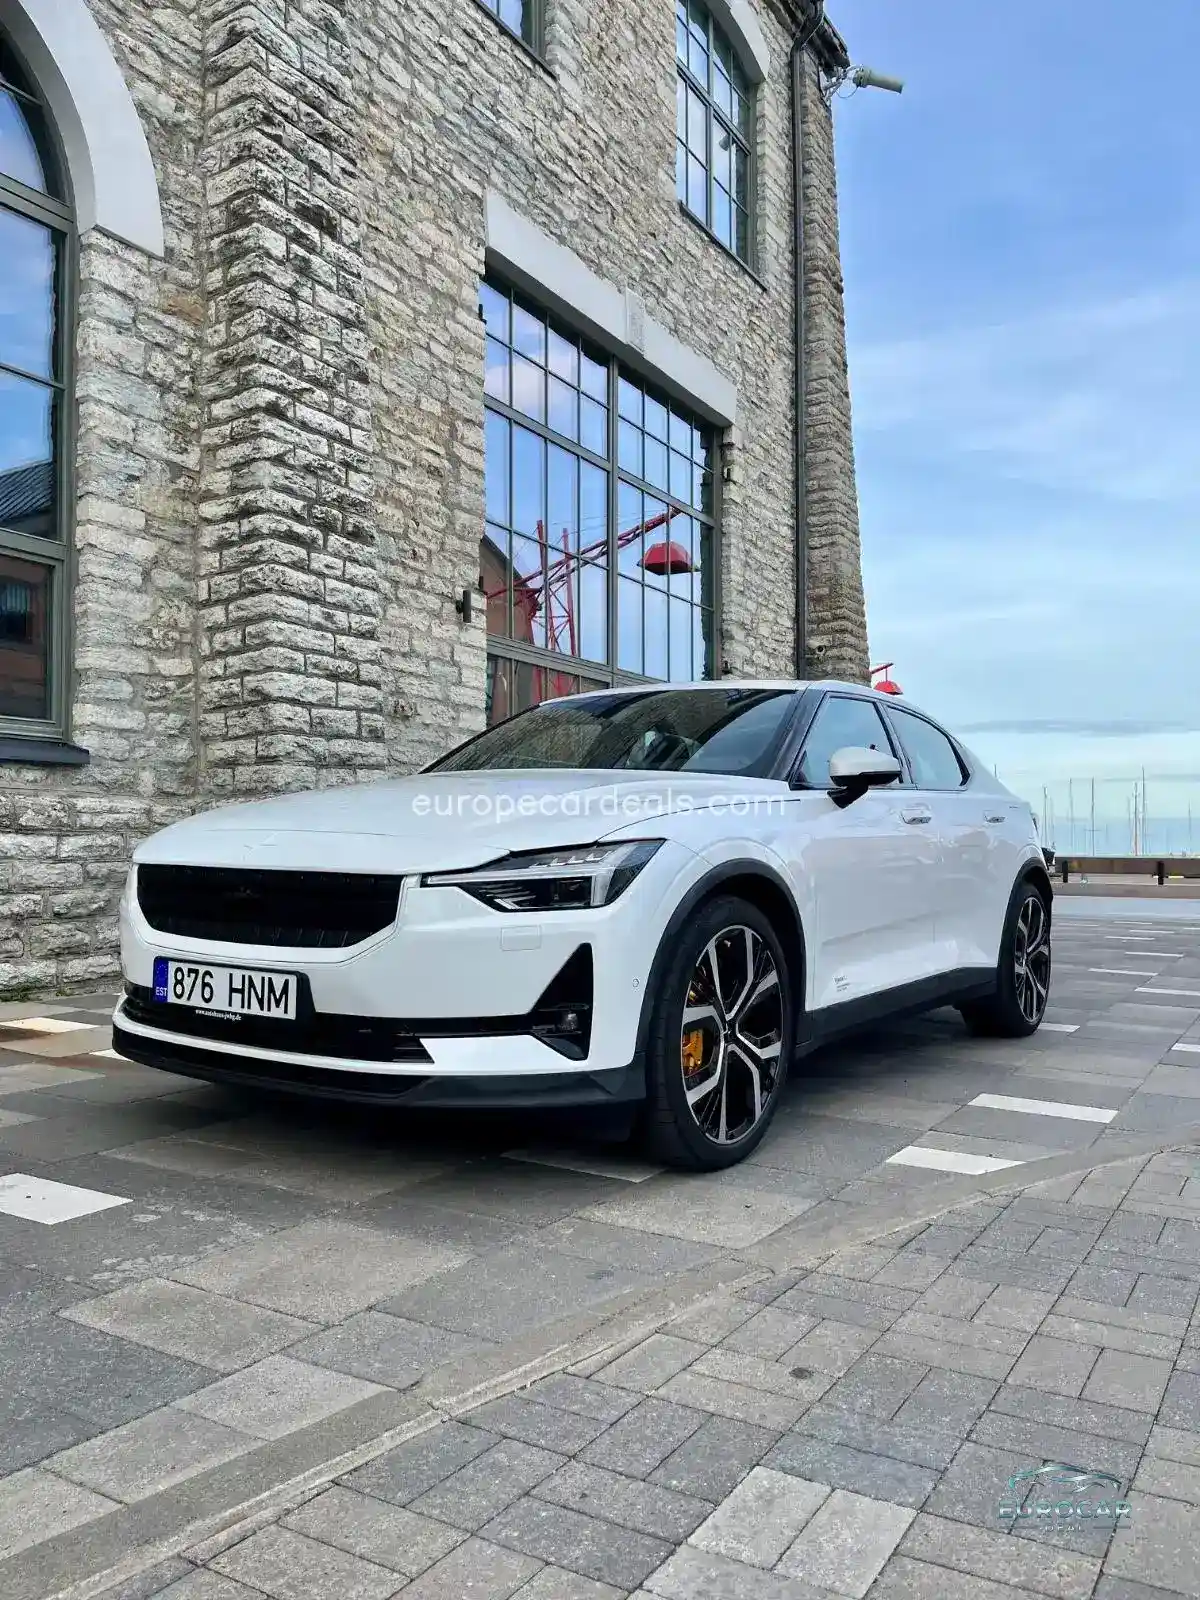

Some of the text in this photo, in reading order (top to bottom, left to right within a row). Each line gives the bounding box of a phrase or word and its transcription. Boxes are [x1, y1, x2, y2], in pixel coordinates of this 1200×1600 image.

[155, 987, 168, 996] EST
[173, 966, 290, 1015] 876 HNM
